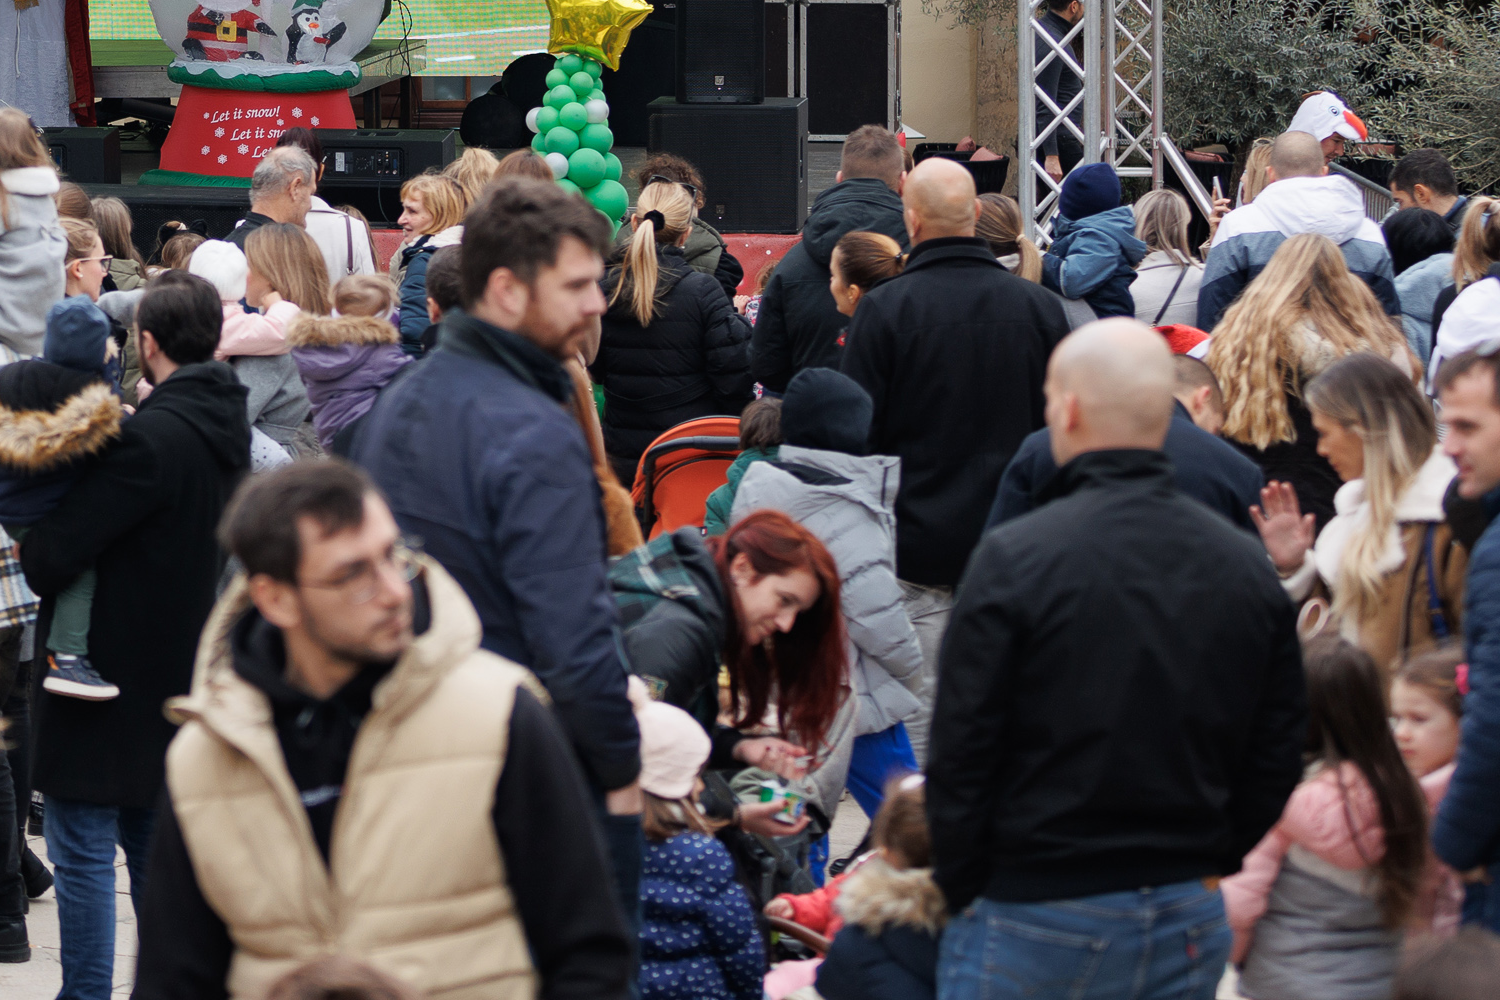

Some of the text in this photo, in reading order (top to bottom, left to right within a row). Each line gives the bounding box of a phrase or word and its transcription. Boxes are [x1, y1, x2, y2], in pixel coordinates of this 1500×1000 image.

[210, 105, 281, 124] Let it snow!
[230, 128, 252, 141] Let
[254, 126, 266, 139] it
